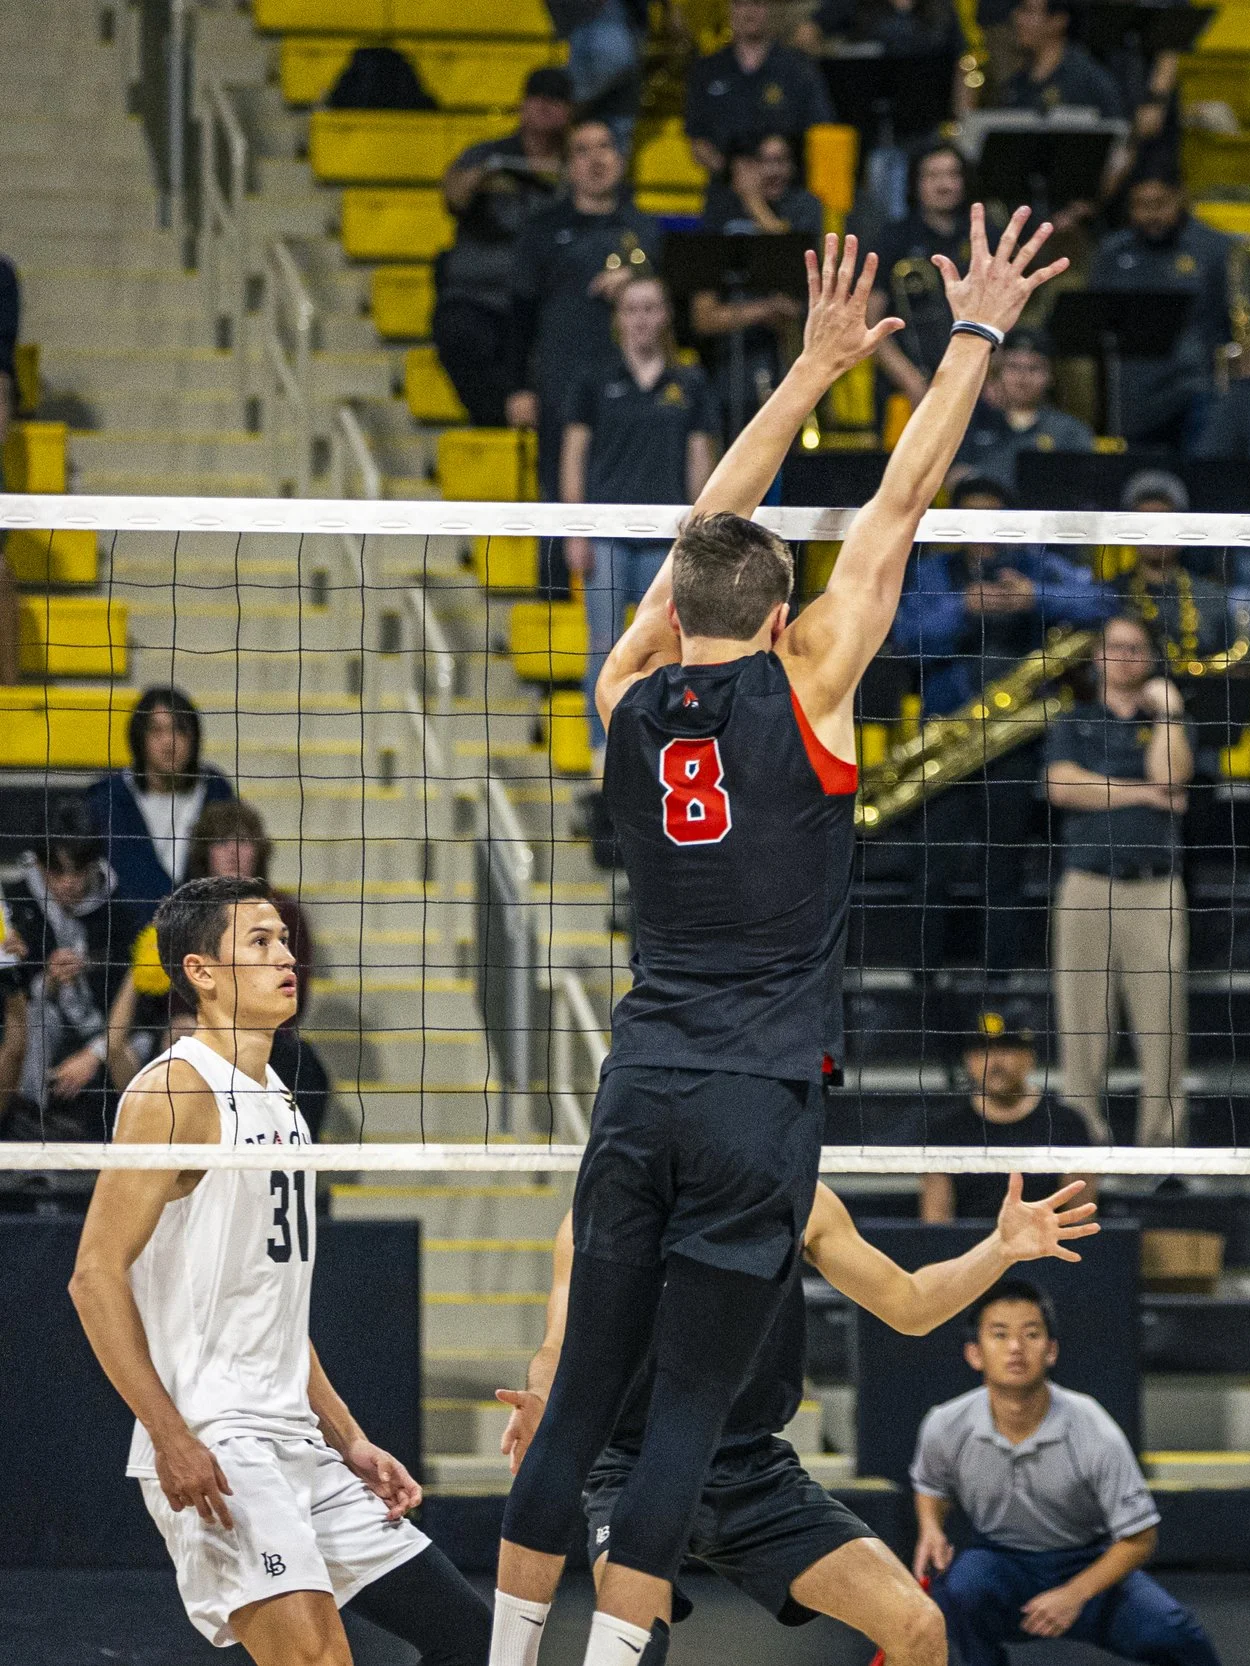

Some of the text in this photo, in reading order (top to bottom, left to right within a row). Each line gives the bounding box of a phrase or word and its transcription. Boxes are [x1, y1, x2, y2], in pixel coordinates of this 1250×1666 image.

[659, 737, 732, 846] 8
[267, 1170, 308, 1263] 31
[261, 1551, 286, 1577] LB
